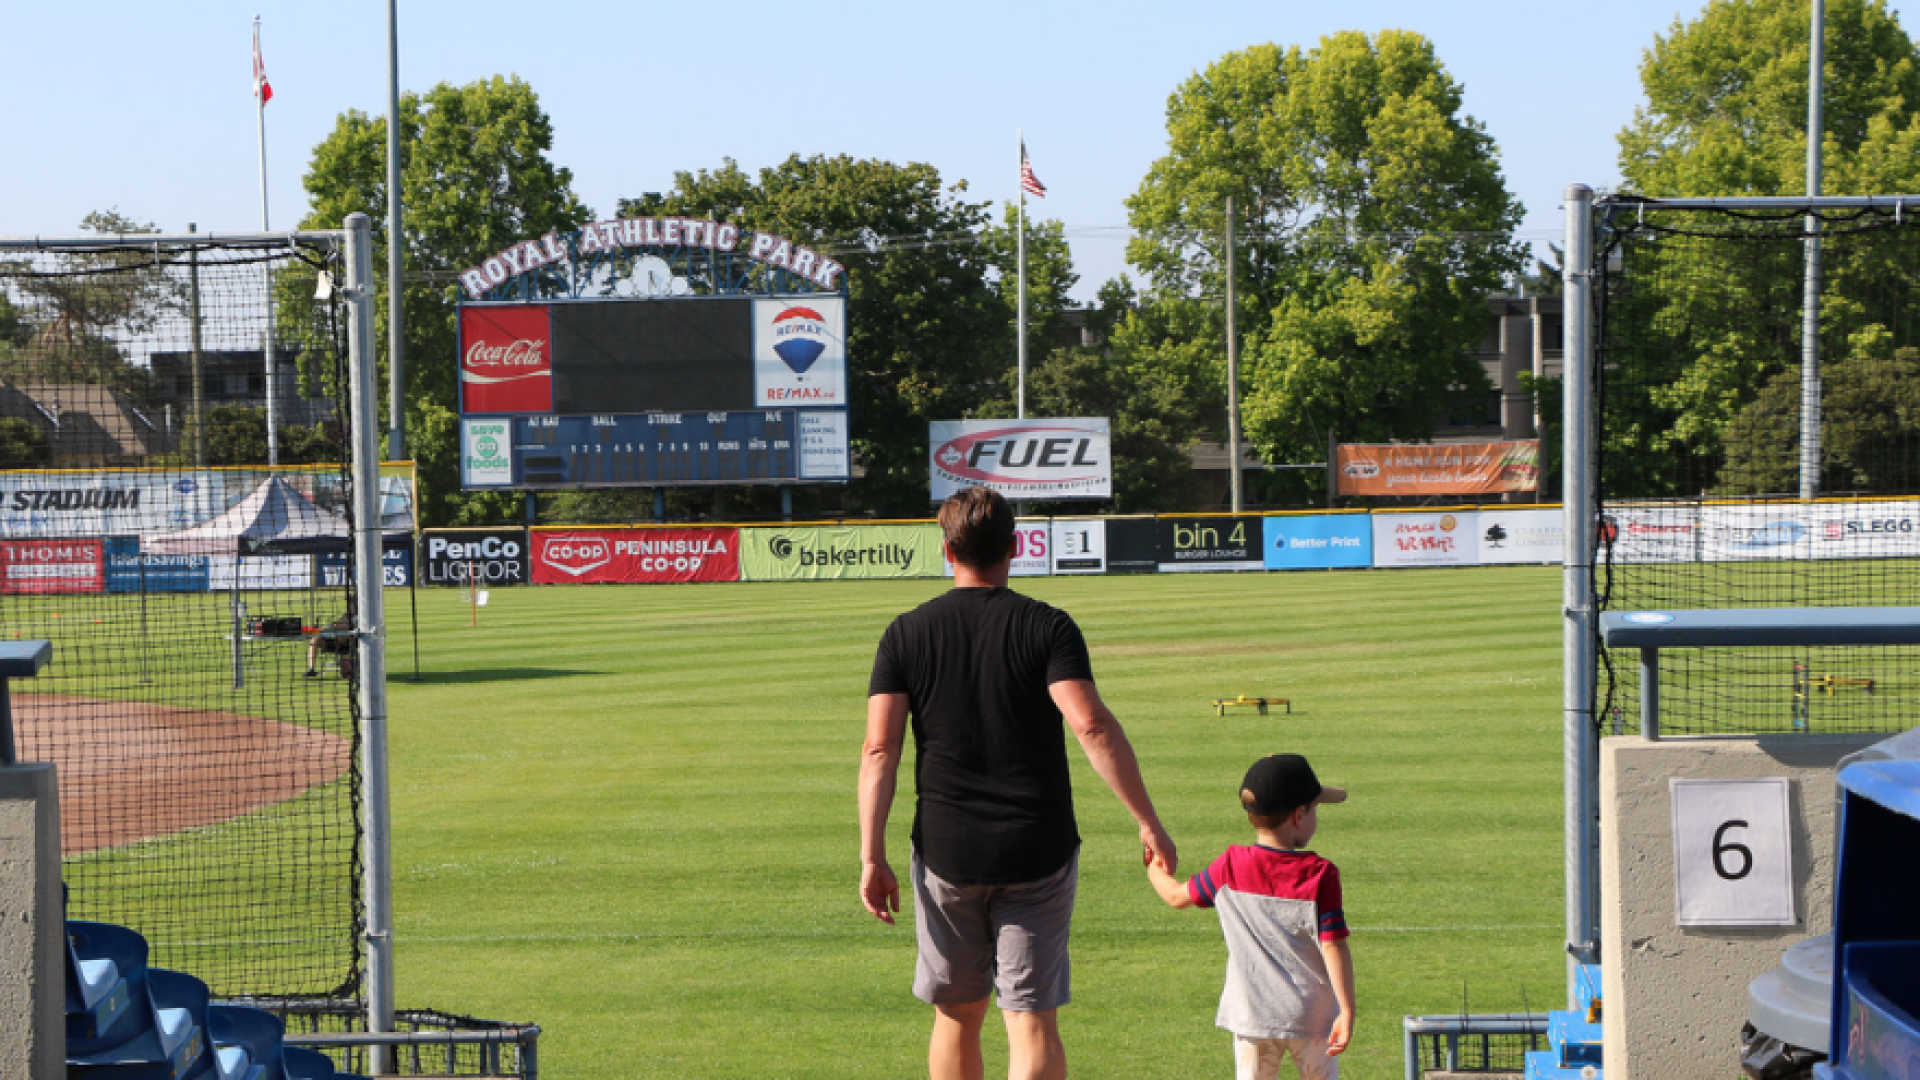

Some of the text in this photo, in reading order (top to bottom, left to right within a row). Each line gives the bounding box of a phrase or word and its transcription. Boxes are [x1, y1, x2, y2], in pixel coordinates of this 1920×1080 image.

[459, 216, 845, 298] ROYAL ATHLETIC PARK
[466, 340, 546, 366] Coca-Cola
[592, 415, 618, 426] BALL
[648, 413, 684, 425] STRIKE
[707, 411, 728, 423] OUT
[466, 455, 509, 469] foods
[967, 438, 1098, 467] FUEL
[13, 488, 141, 511] STADIUM
[1079, 529, 1092, 554] 1
[1173, 521, 1247, 549] bin 4
[1289, 536, 1361, 548] Better Print
[429, 536, 520, 559] PenCo
[549, 544, 604, 560] CO-OP
[614, 539, 728, 555] PENINSULA
[800, 543, 915, 571] bakertilly
[429, 560, 521, 581] LIQUOR
[1711, 818, 1754, 881] 6
